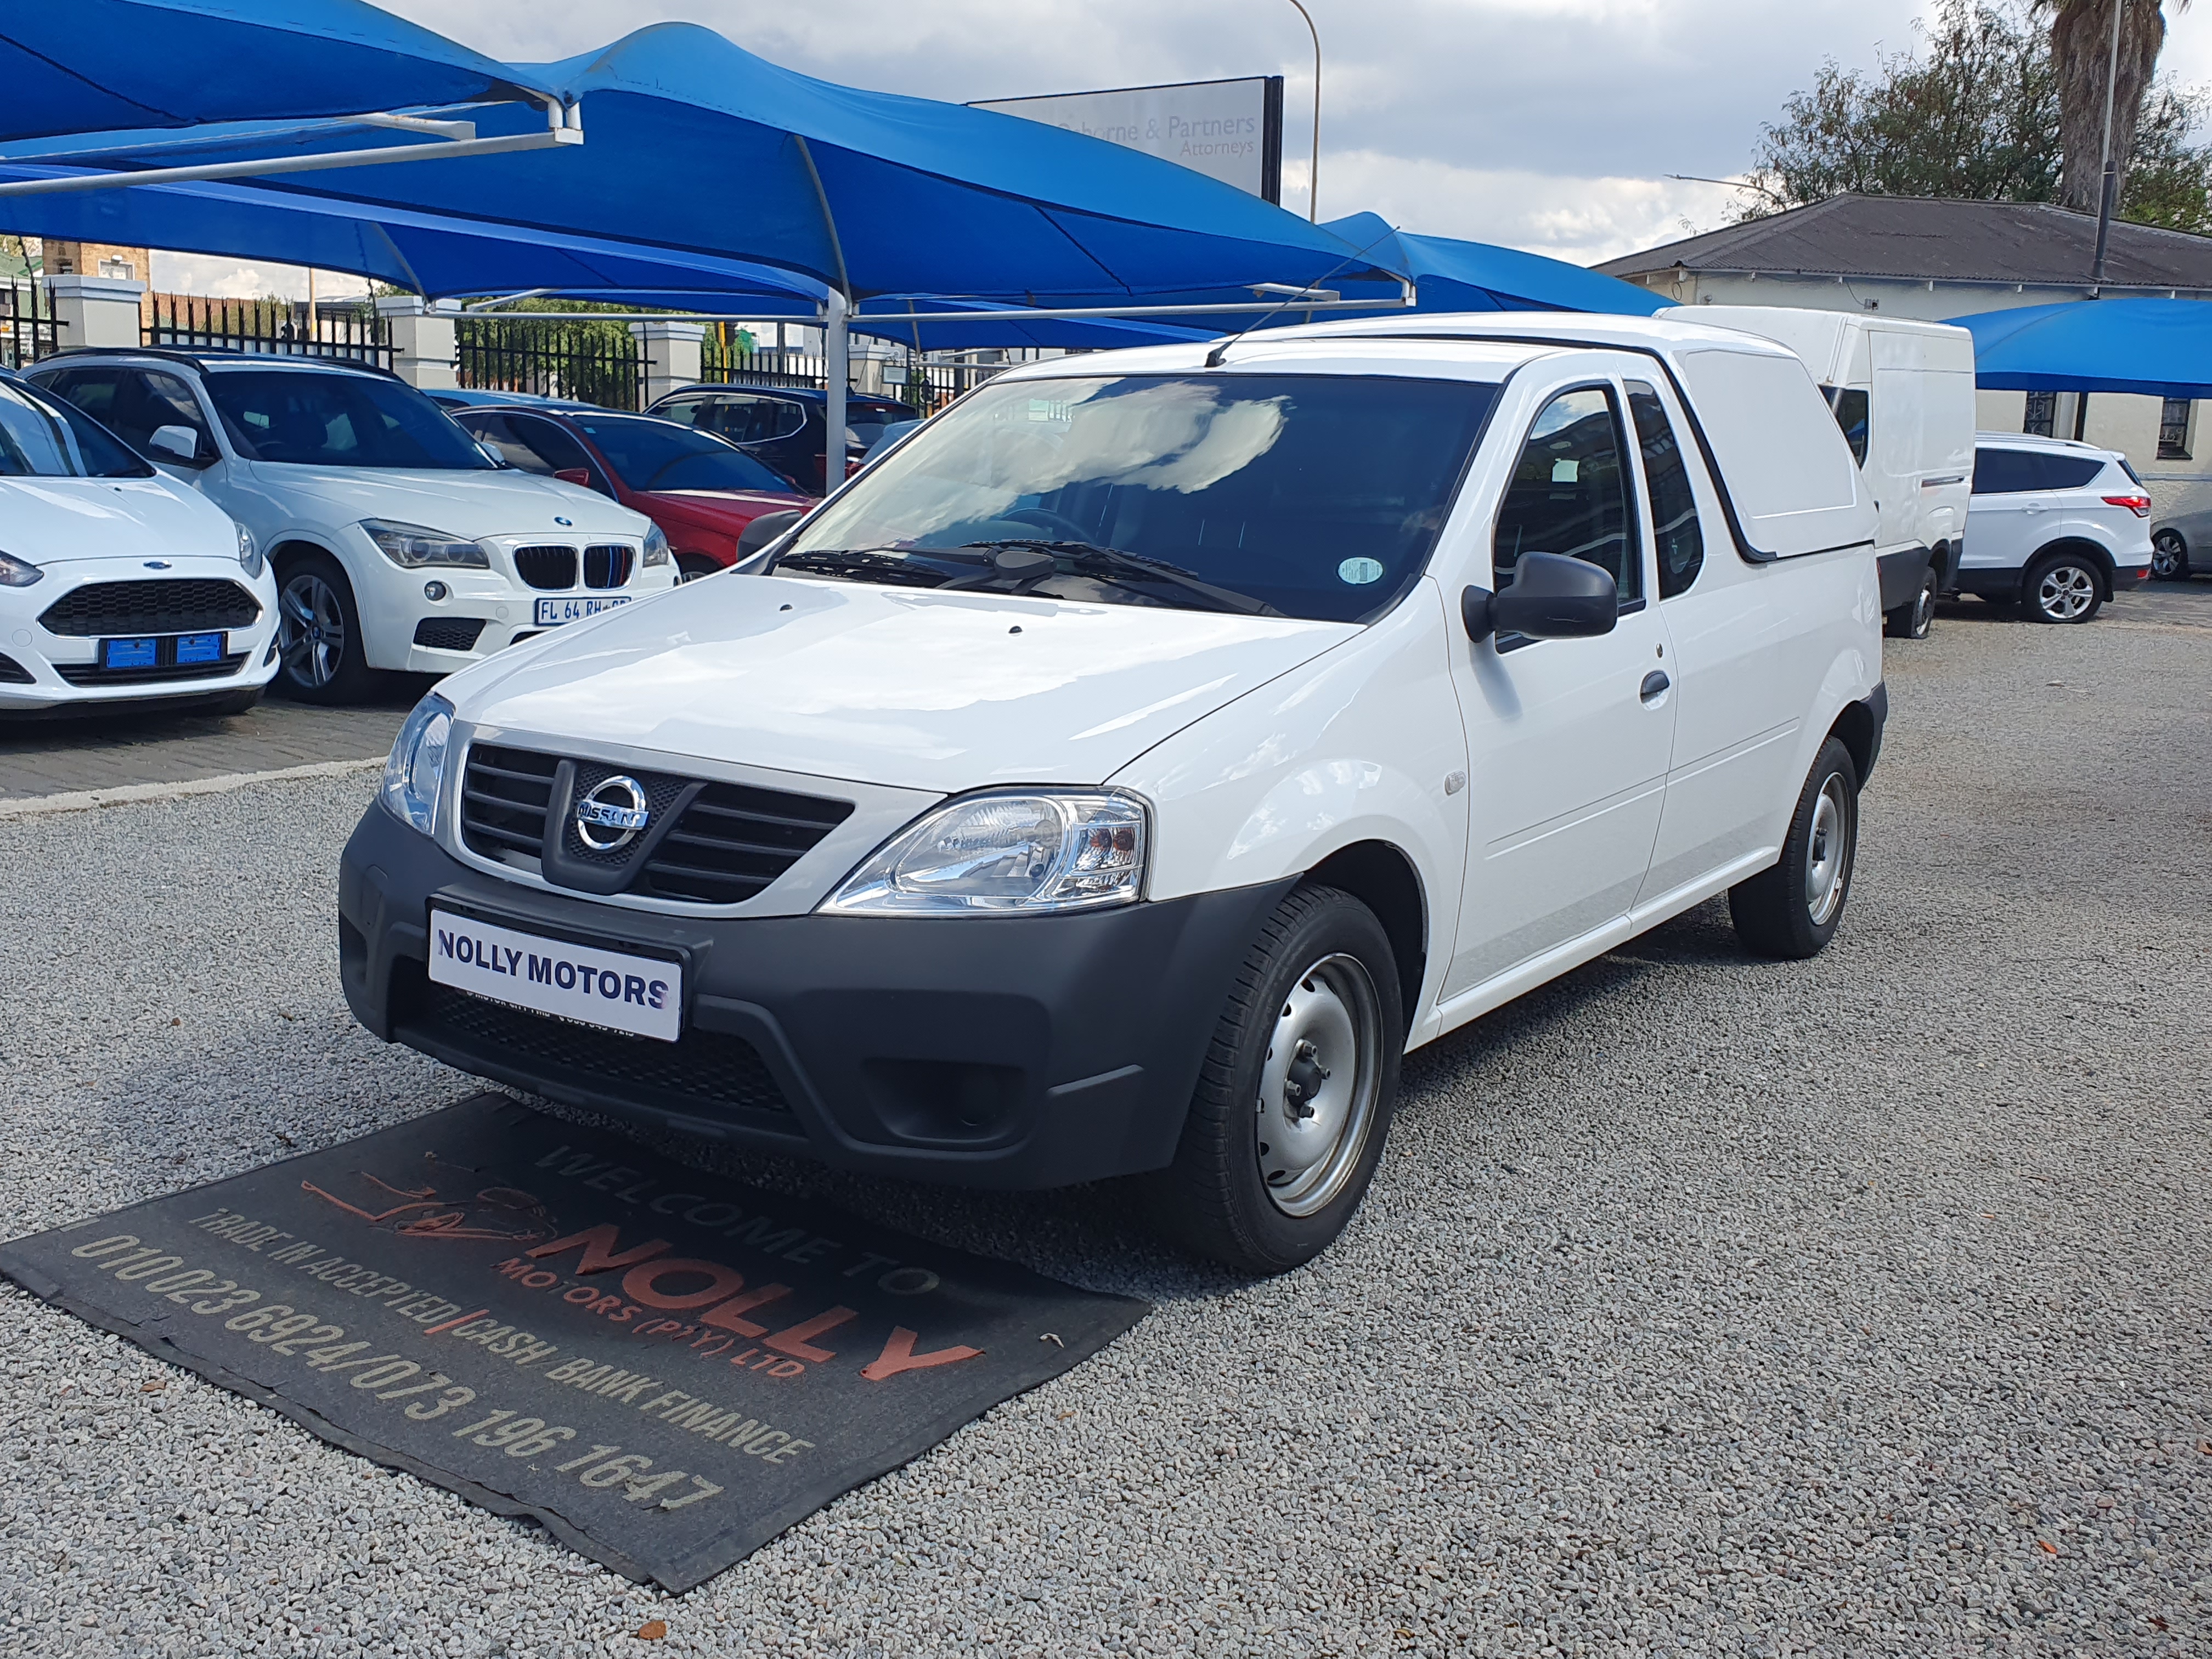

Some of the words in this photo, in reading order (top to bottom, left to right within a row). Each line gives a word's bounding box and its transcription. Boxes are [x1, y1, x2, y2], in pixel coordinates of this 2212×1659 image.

[1146, 117, 1161, 140] &
[1168, 116, 1255, 139] Partners
[1180, 139, 1254, 158] Attorneys
[541, 601, 558, 619] FL
[565, 601, 580, 619] 64
[578, 803, 640, 826] NISSAN
[438, 929, 523, 977] NOLLY
[528, 953, 669, 1009] MOTORS
[534, 1145, 842, 1263] WELCOME
[842, 1251, 940, 1295] TO
[524, 1222, 986, 1381] NOLLY
[188, 1207, 295, 1251] TRADE
[267, 1241, 327, 1265] IN
[545, 1357, 663, 1403] BANK
[638, 1390, 815, 1463] FINANCE
[730, 1348, 805, 1377] LTD
[450, 1408, 577, 1457] 196
[553, 1444, 725, 1510] 1647
